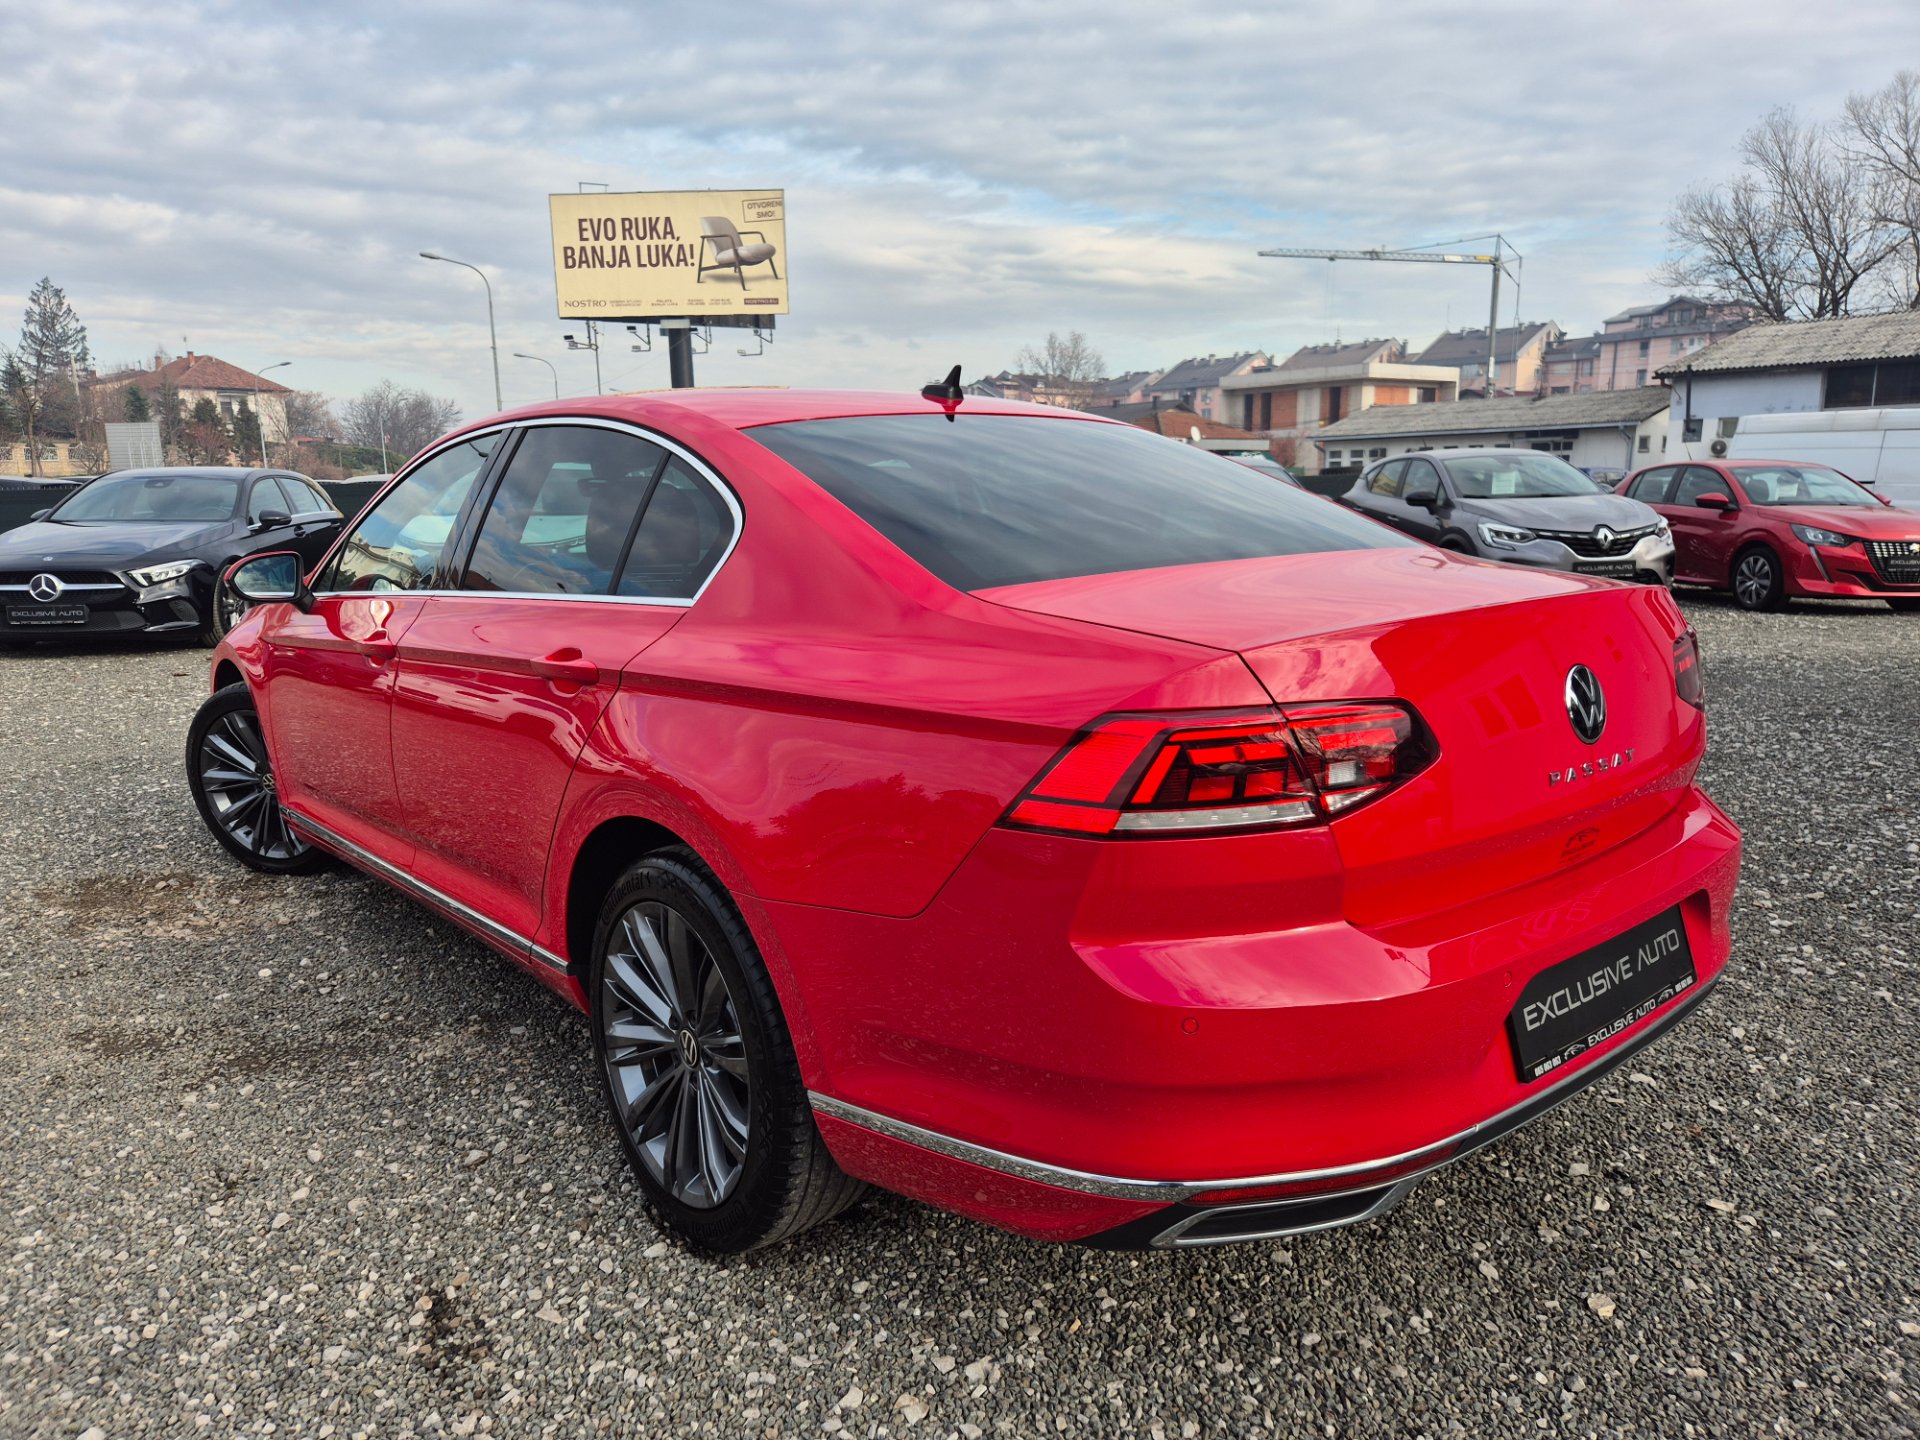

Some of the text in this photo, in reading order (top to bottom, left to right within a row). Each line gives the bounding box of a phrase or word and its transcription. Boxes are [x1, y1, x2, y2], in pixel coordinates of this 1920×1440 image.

[578, 216, 681, 242] EVO RUKA,
[564, 243, 695, 269] BANJA LUKA!
[564, 299, 607, 308] NOSTRO
[1548, 748, 1636, 788] PASSAT
[1522, 927, 1680, 1032] EXCLUSIVE AUTO
[1588, 998, 1657, 1047] EXCLUSIVE AUTO
